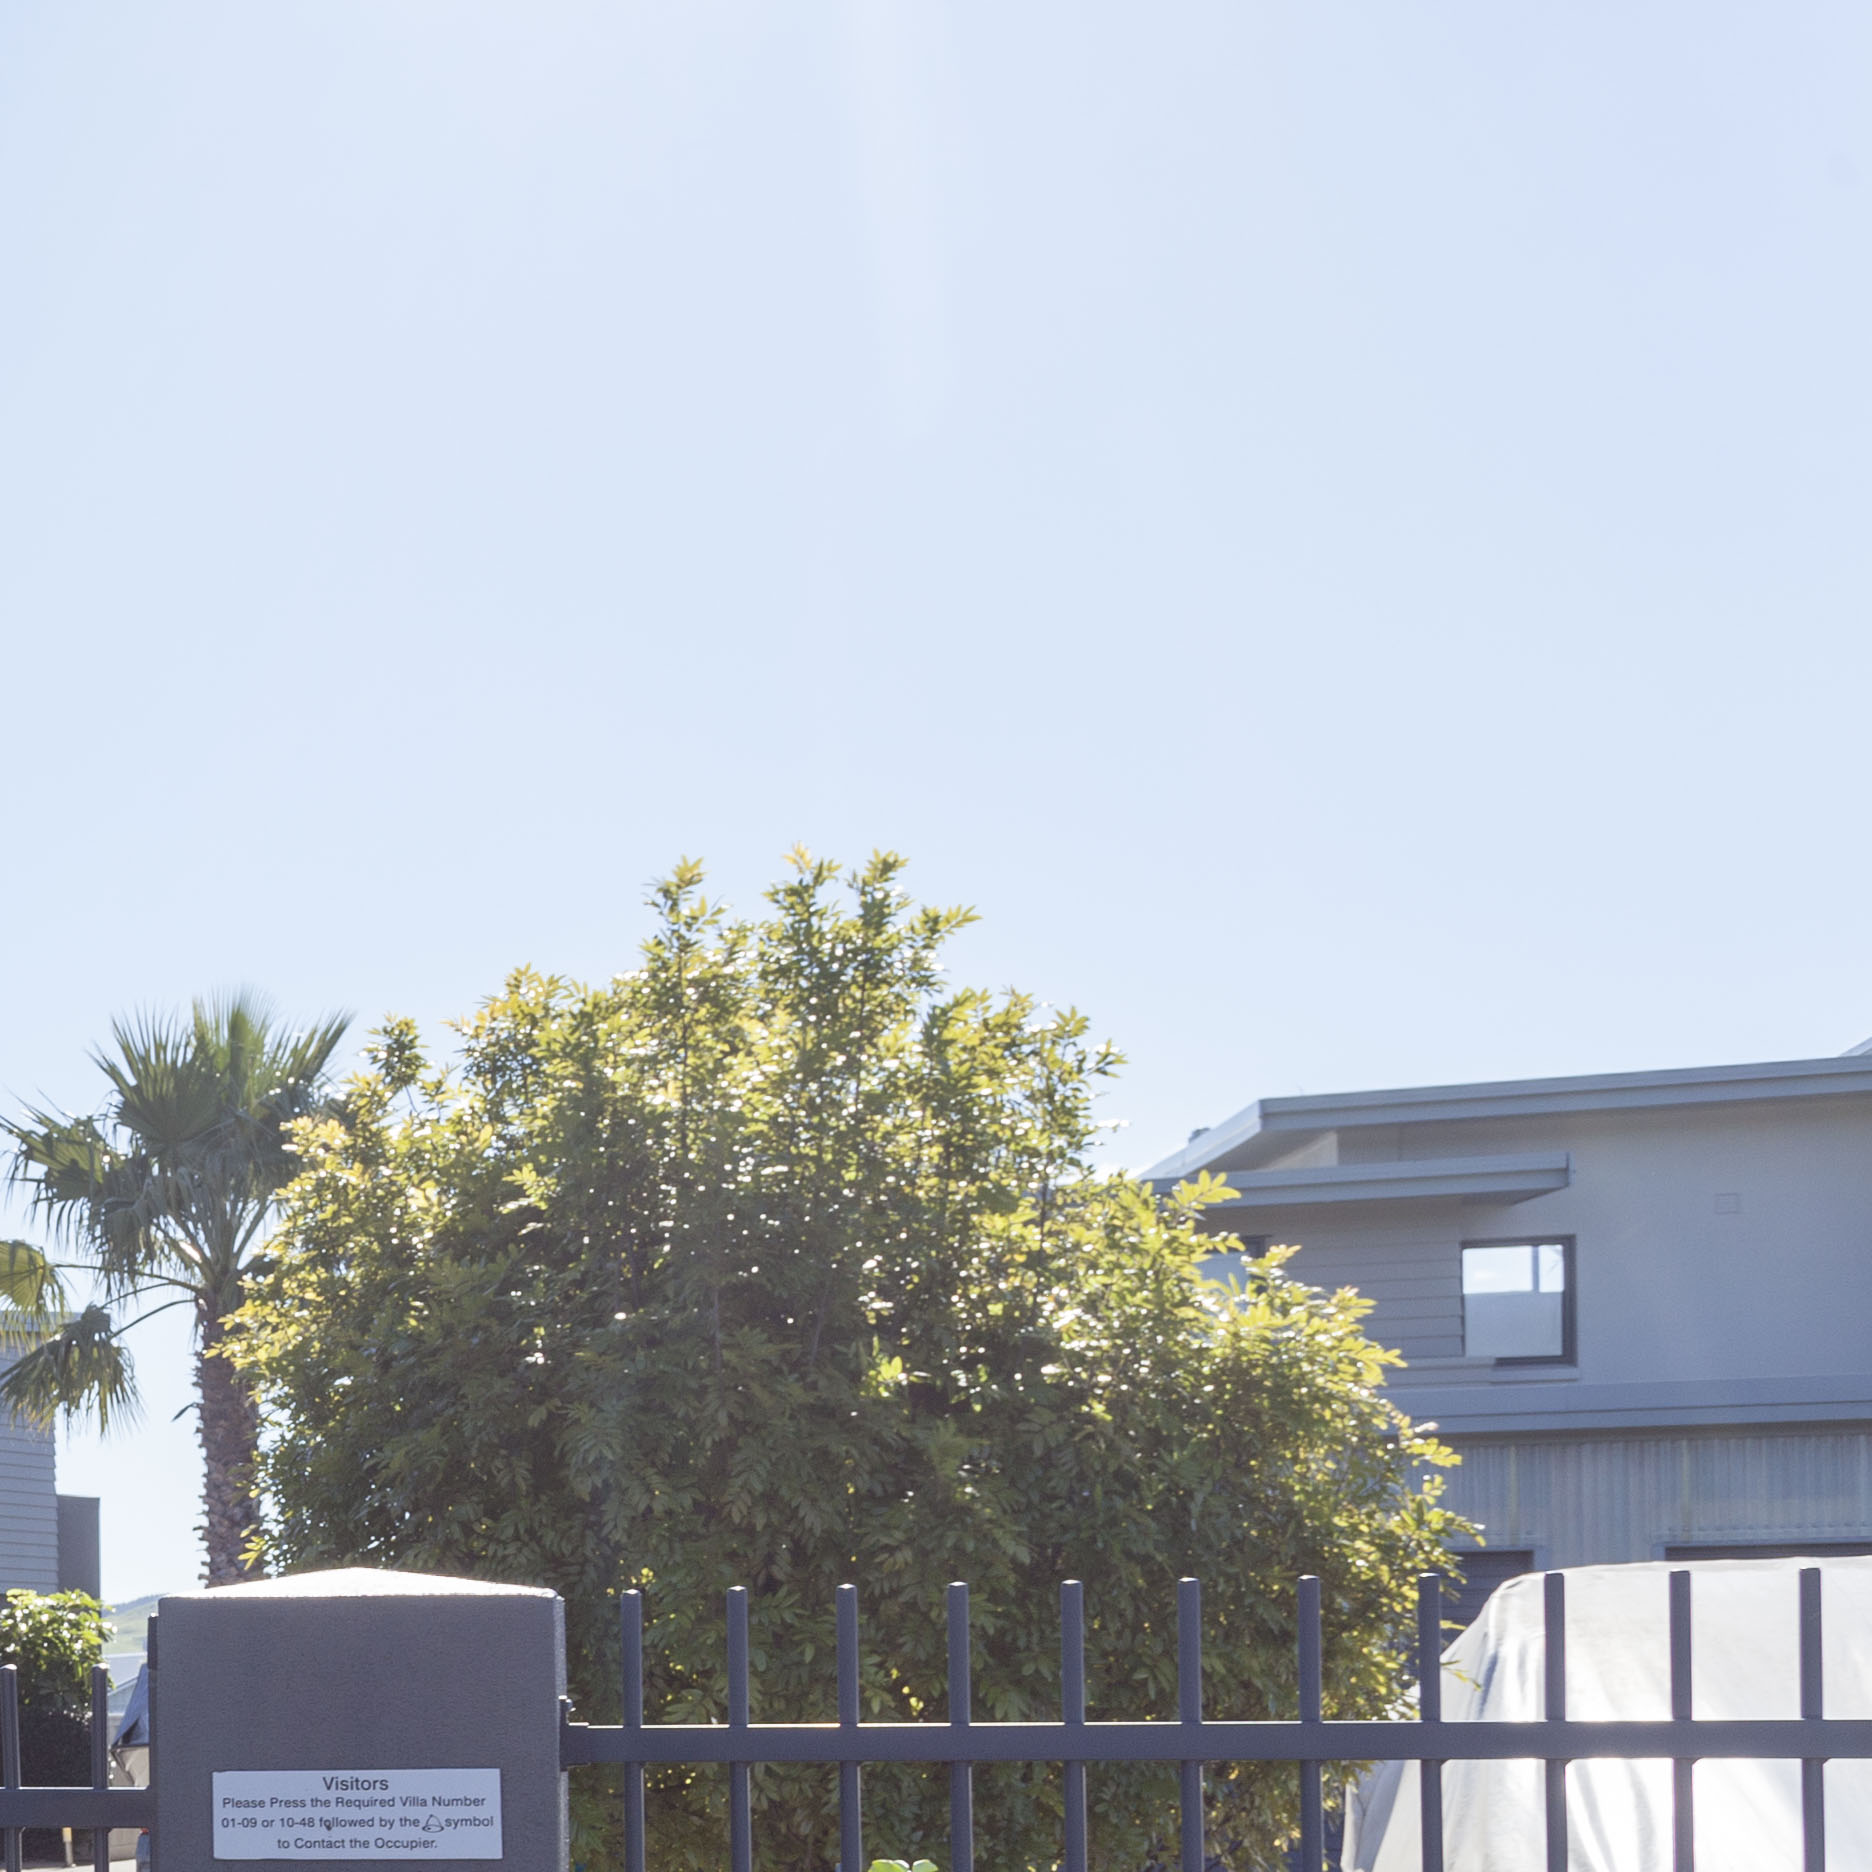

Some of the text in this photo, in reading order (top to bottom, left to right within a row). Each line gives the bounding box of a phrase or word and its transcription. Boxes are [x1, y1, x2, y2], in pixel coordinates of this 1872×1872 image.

[323, 1777, 389, 1791] Visitors
[222, 1796, 485, 1810] Please Press the Required Villa Number
[221, 1817, 493, 1829] 01-09 or 10-48 followed by the symbol
[277, 1838, 438, 1850] to Contact the Occupier.
